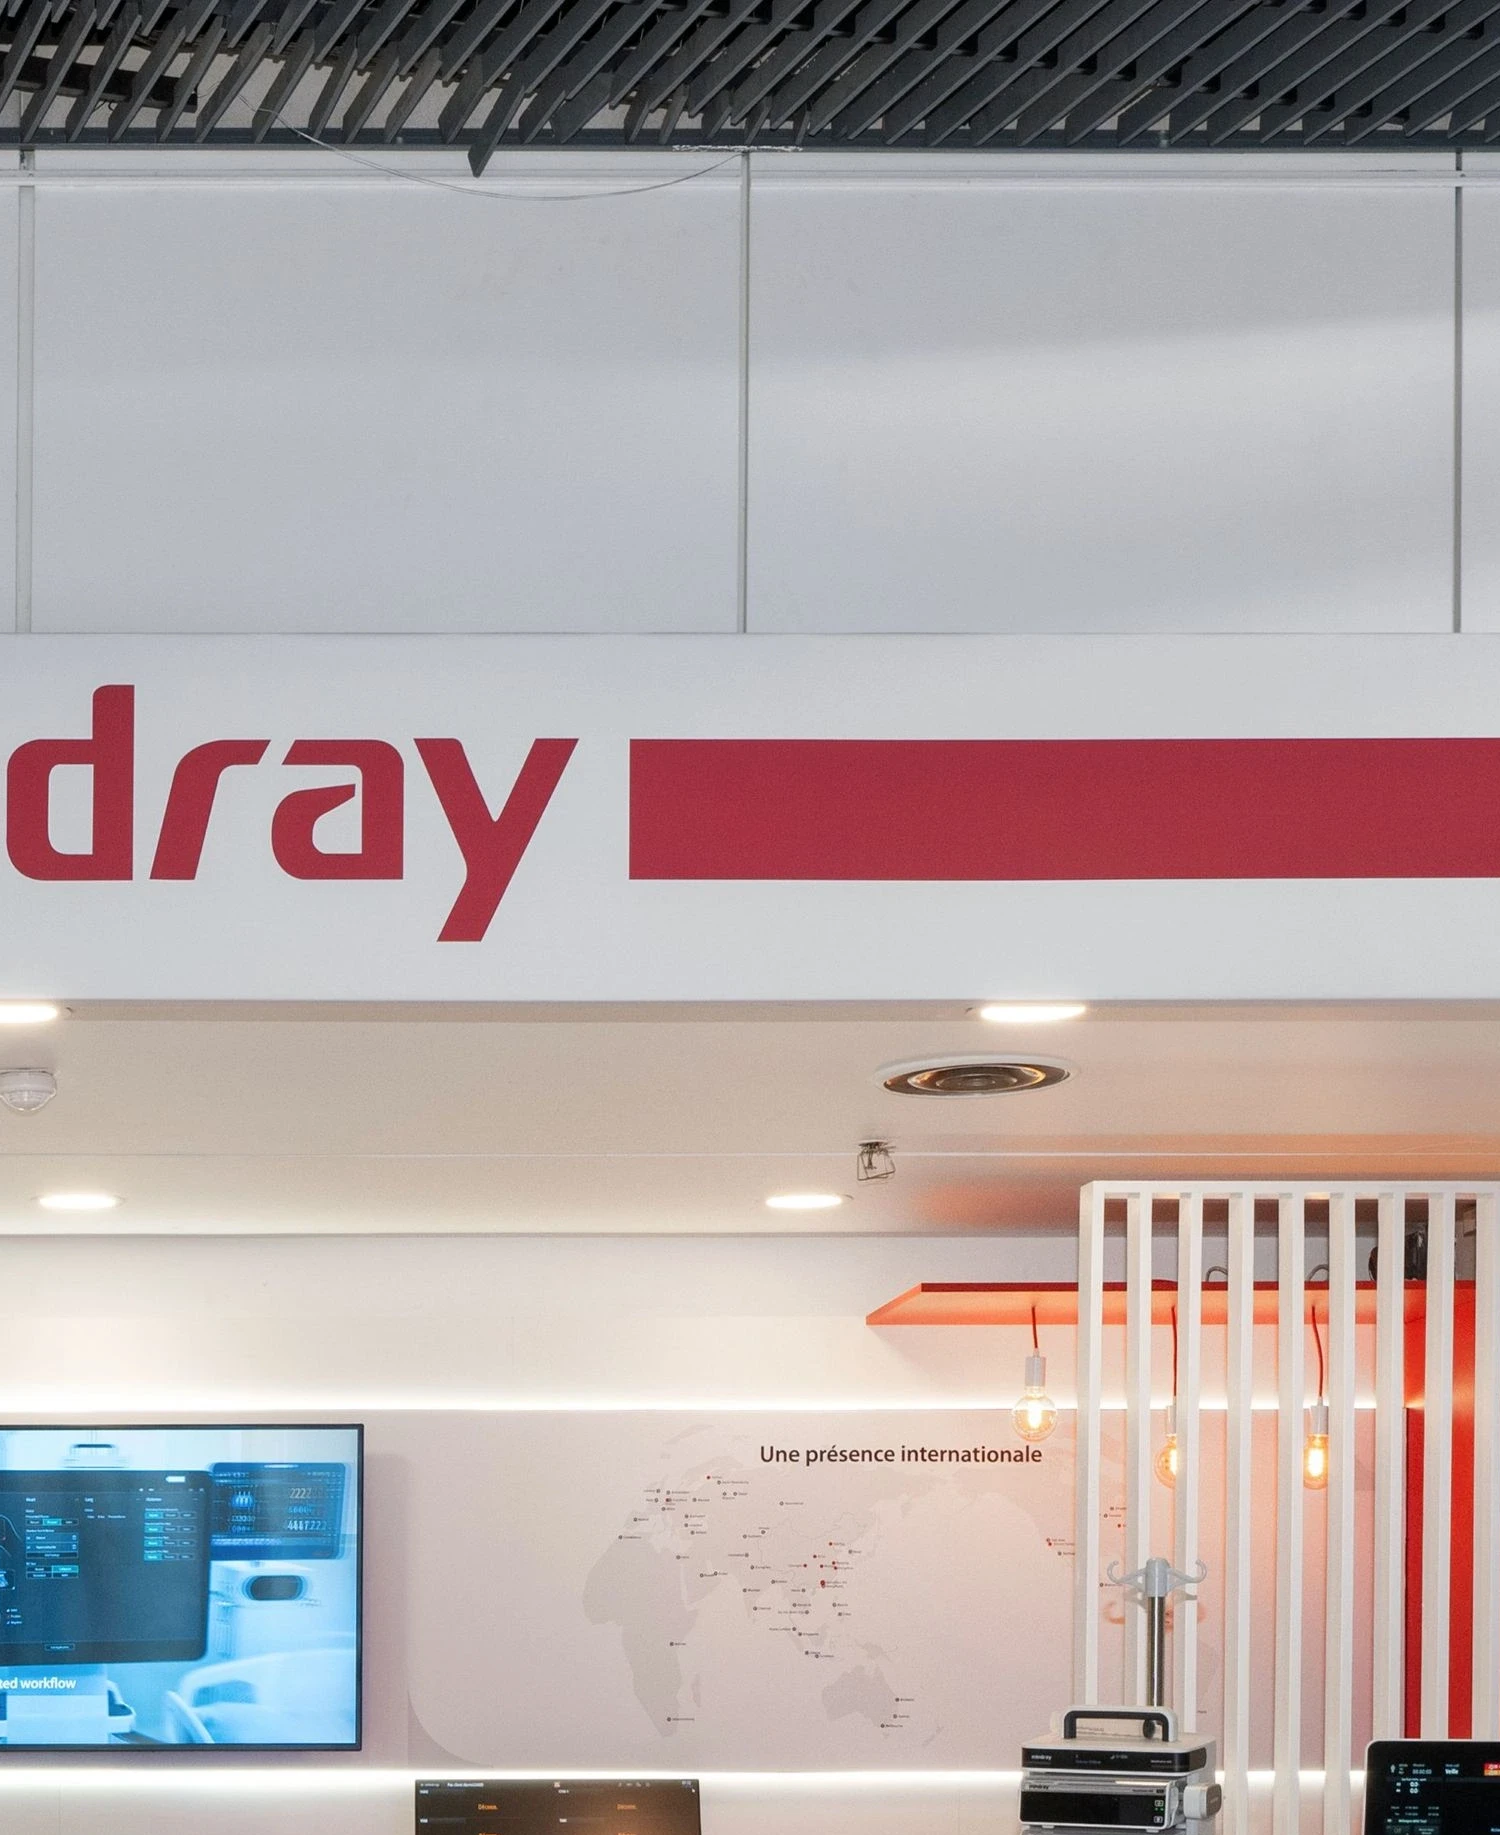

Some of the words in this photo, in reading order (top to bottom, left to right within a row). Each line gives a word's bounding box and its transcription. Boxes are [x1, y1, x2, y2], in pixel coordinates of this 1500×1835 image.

[761, 1446, 799, 1462] Une
[806, 1445, 895, 1466] présence
[902, 1445, 1042, 1462] internationale
[20, 1678, 77, 1690] workflow
